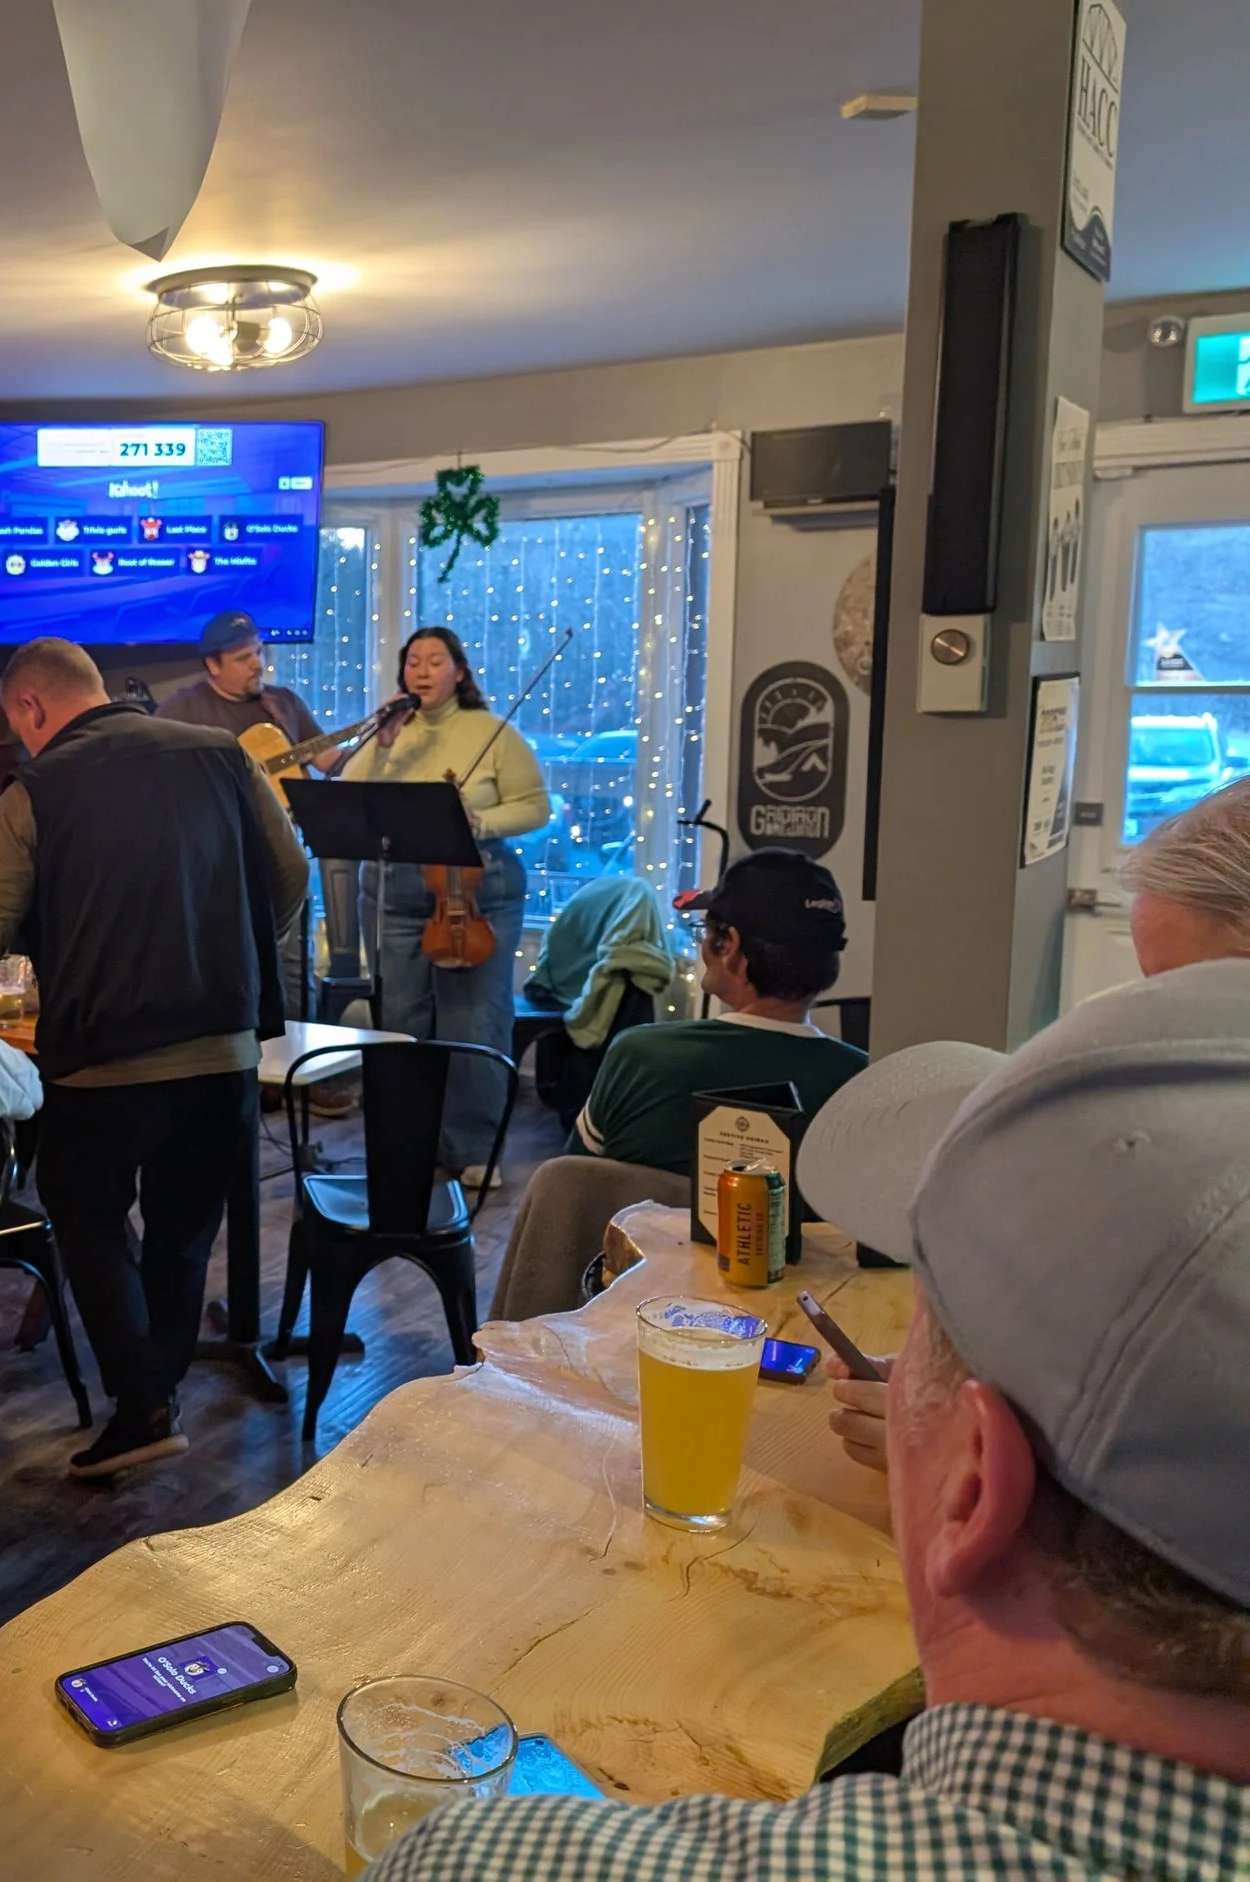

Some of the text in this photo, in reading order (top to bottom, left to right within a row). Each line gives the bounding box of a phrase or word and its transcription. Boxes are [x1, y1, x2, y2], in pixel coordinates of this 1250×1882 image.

[1077, 56, 1118, 159] HACC
[120, 442, 148, 456] 271
[154, 442, 186, 457] 339
[737, 1203, 752, 1265] ATHLETIC
[158, 1657, 197, 1694] O'Solo Ducks
